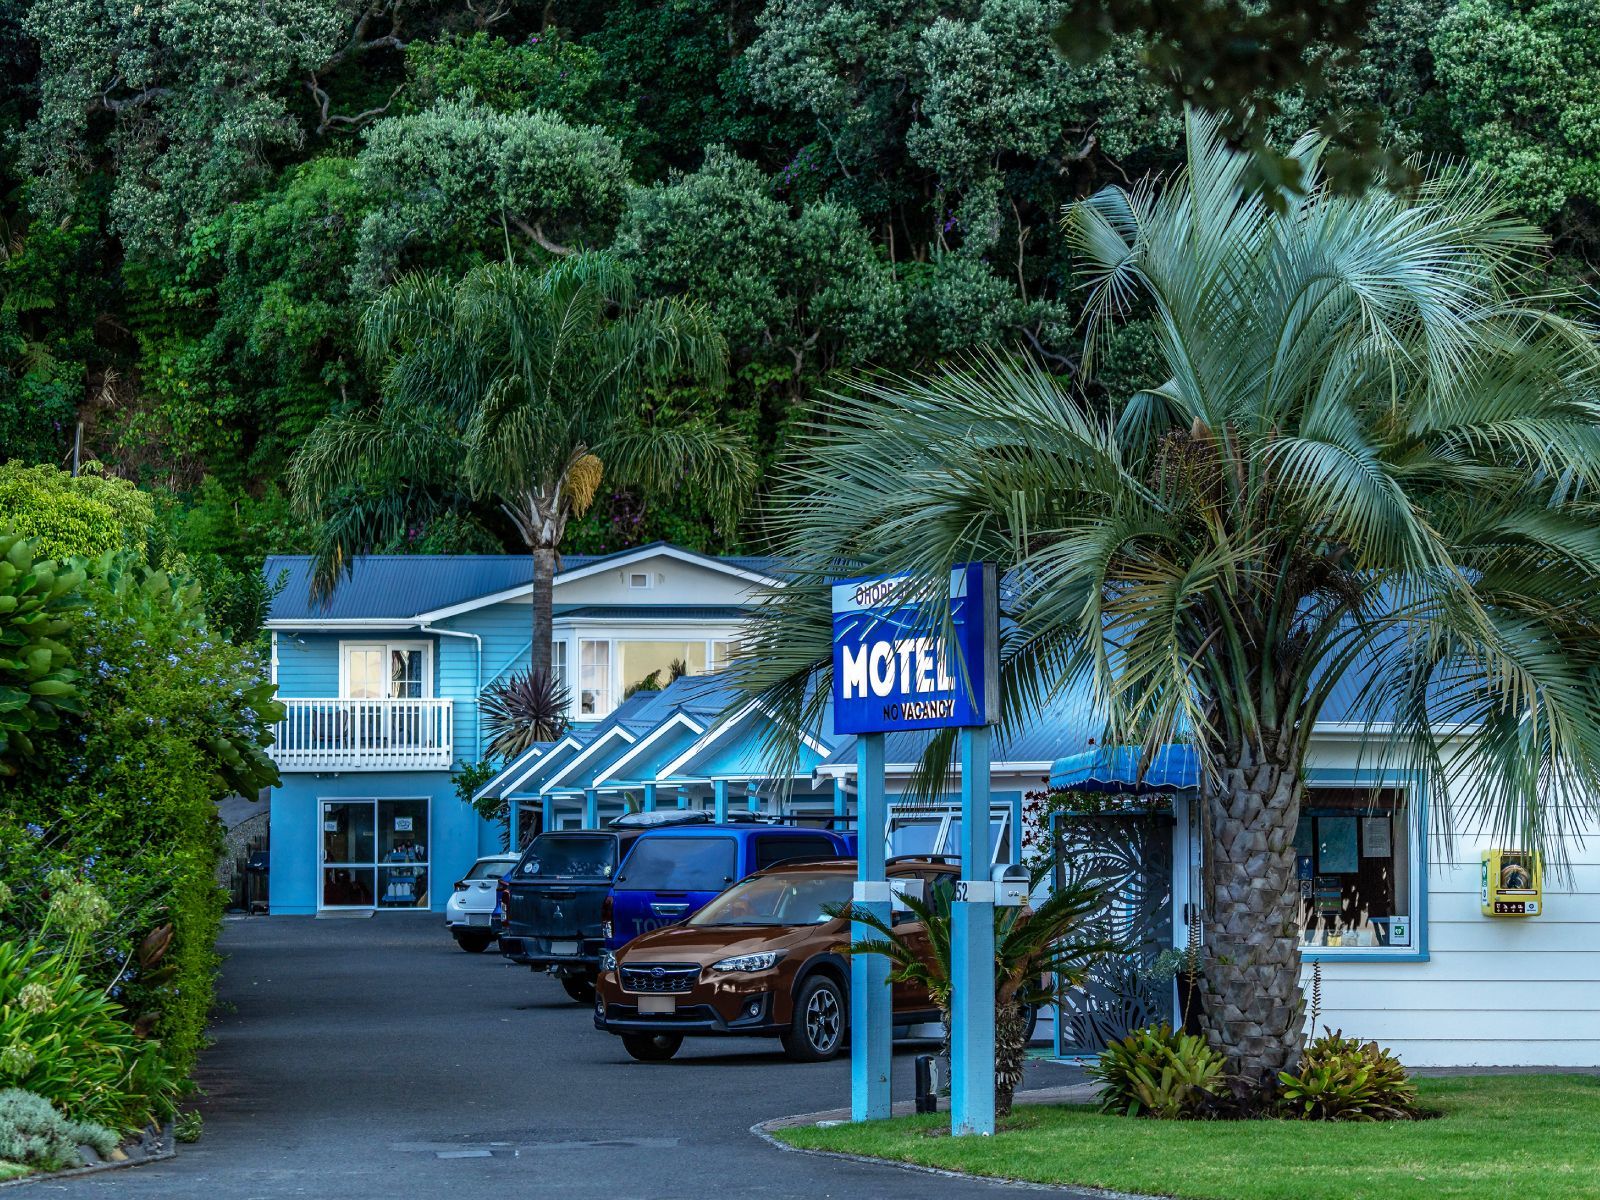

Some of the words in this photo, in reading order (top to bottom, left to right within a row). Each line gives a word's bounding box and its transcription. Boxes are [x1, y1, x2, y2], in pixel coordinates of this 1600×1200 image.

[842, 636, 956, 699] MOTEL
[883, 703, 899, 720] NO
[901, 699, 956, 720] VACANCY
[956, 882, 968, 901] 52
